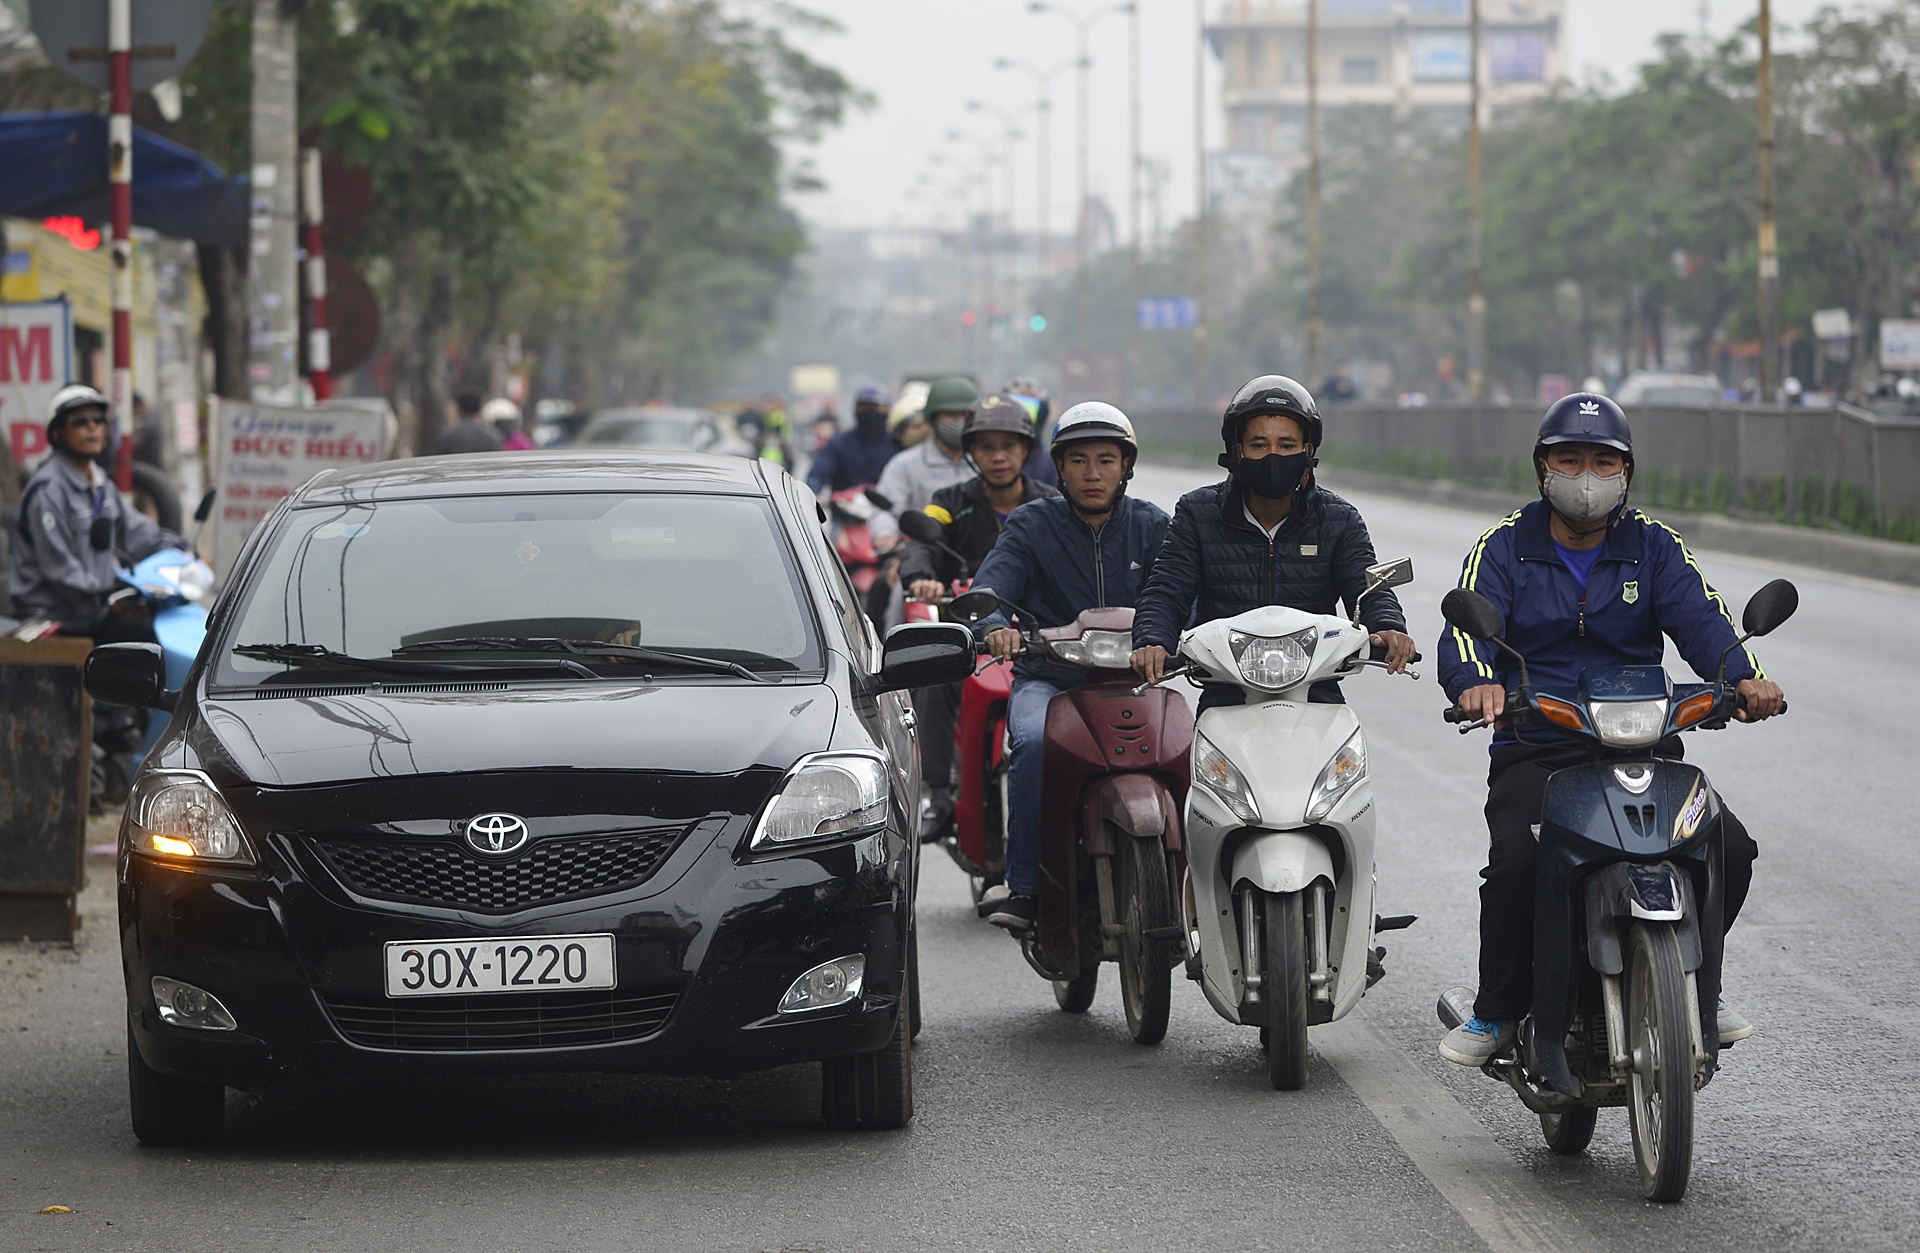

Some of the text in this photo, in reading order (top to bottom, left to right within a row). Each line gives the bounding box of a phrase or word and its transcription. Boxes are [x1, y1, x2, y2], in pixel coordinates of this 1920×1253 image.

[1193, 808, 1214, 828] HONDA
[1351, 802, 1372, 823] HONDA
[1683, 788, 1706, 831] Sirius
[400, 942, 588, 990] 30X-1220
